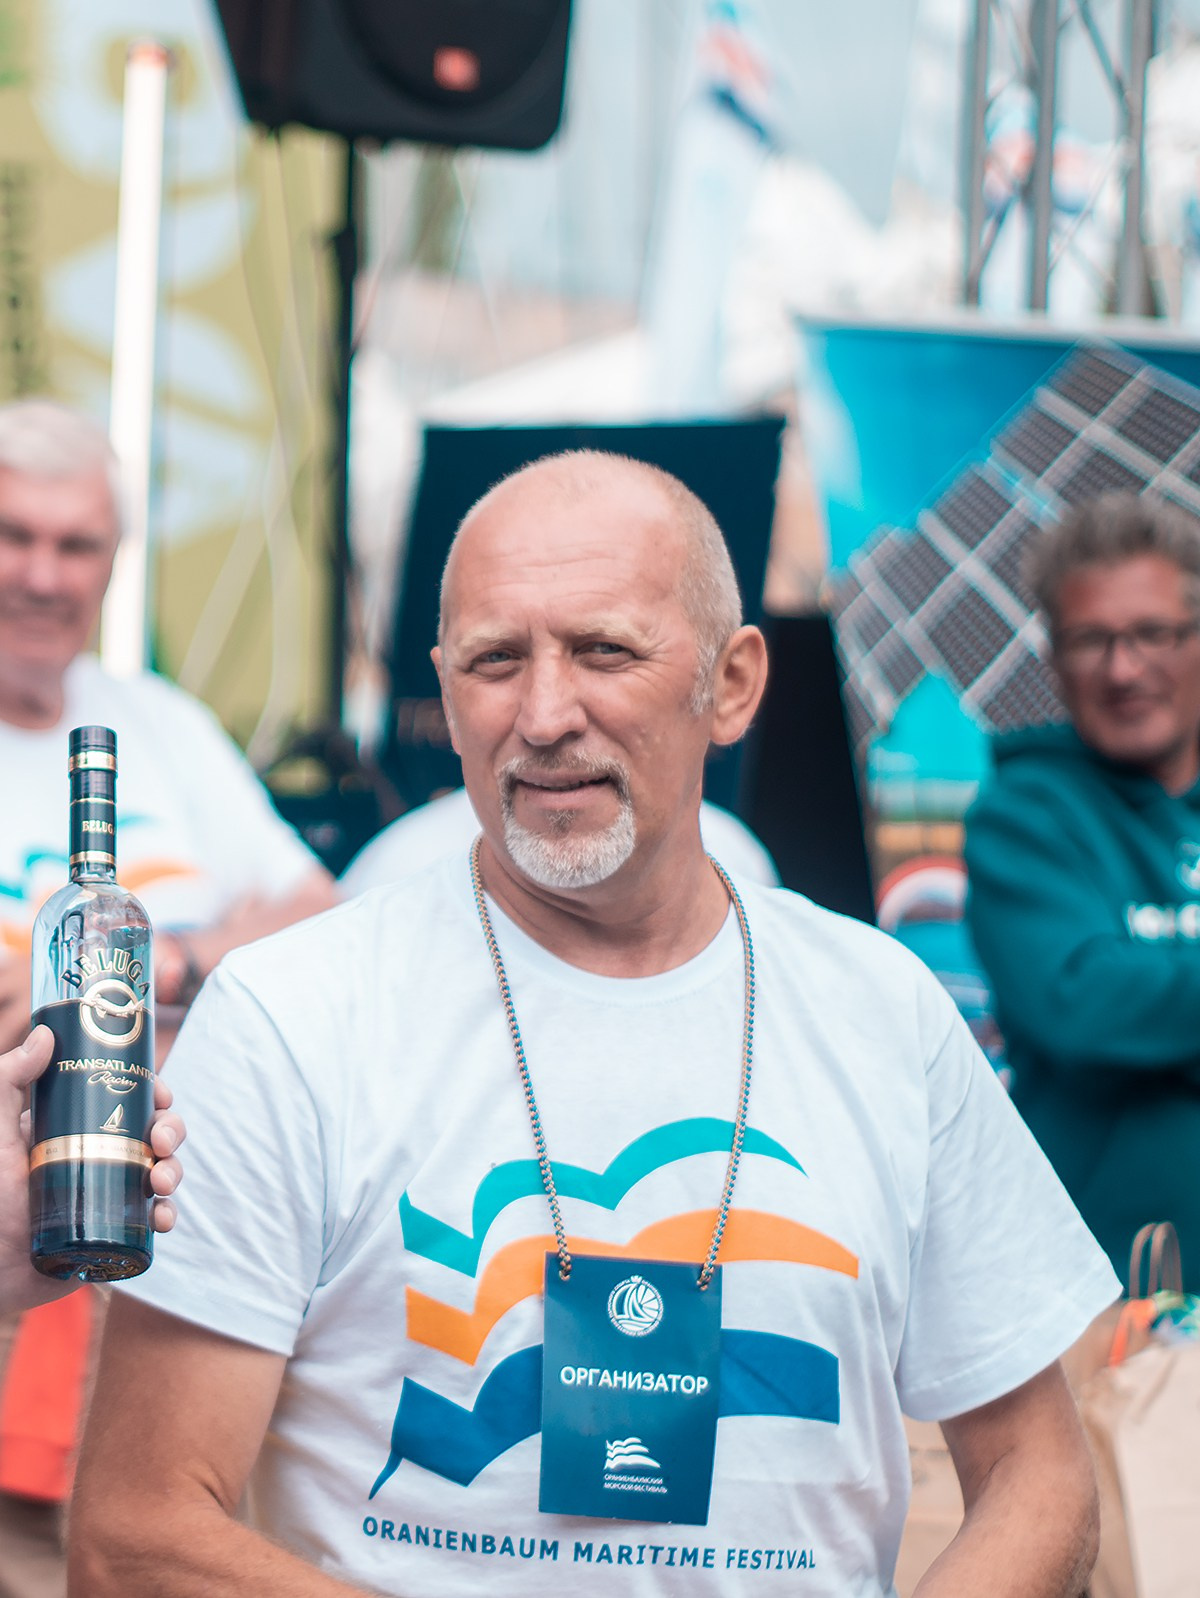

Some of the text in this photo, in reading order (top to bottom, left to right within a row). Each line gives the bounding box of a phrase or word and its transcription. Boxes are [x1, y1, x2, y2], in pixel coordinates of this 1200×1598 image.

[81, 820, 115, 836] BELUG
[61, 947, 150, 997] BELUGA
[87, 1070, 138, 1094] Racing
[560, 1365, 709, 1396] ОРГАНИЗАТОР
[362, 1516, 816, 1570] ORANIENBAUM MARITIME FESTIVAL
